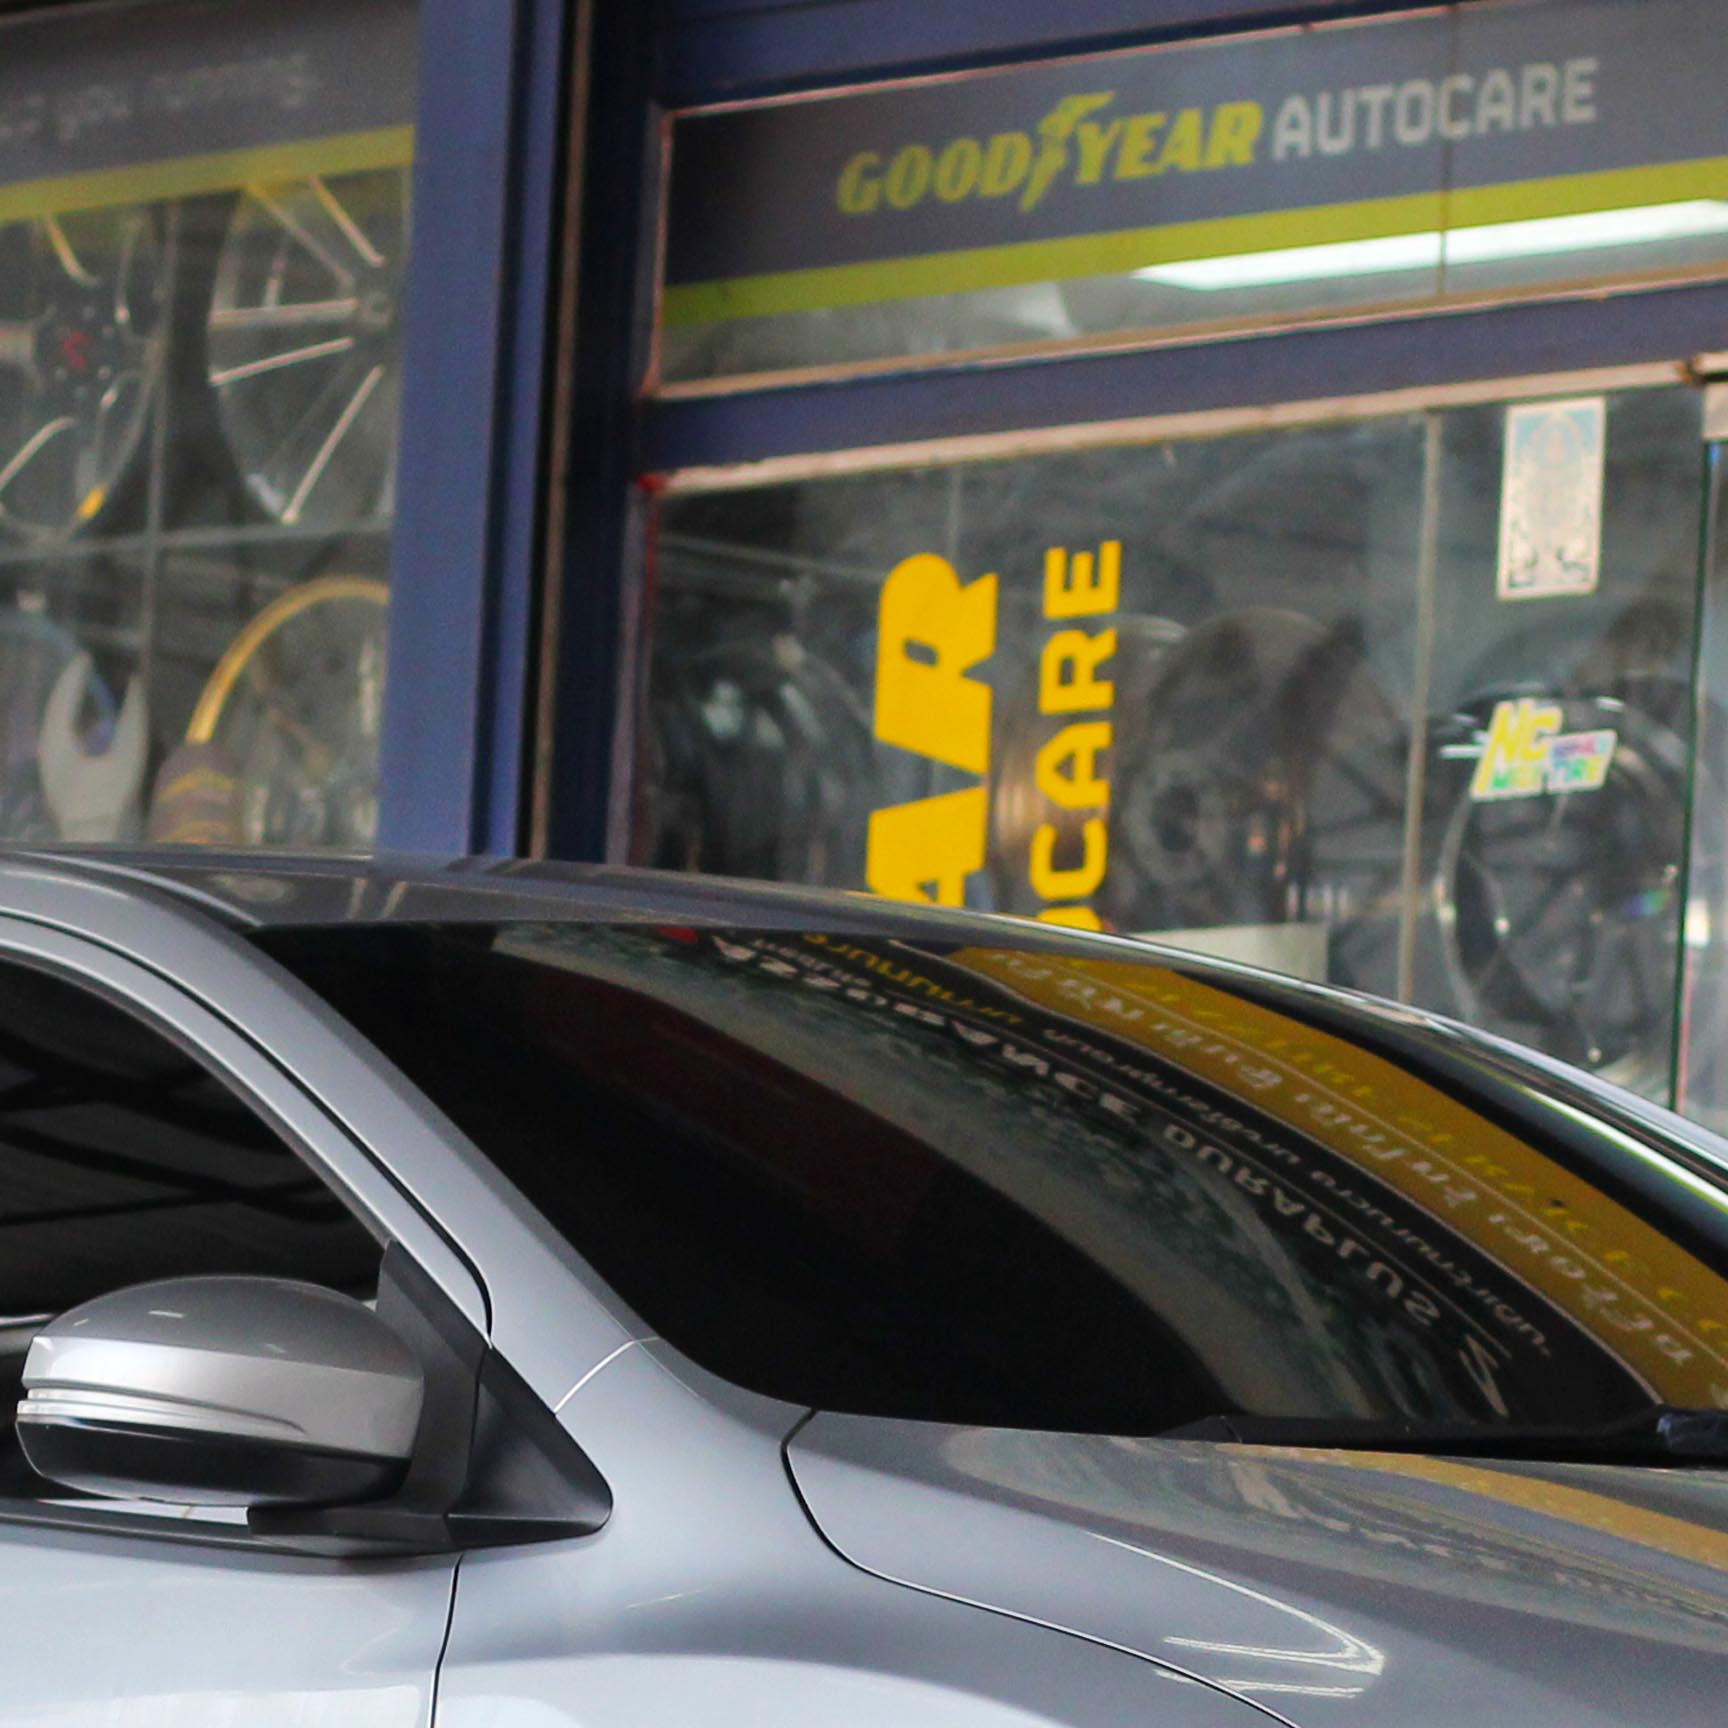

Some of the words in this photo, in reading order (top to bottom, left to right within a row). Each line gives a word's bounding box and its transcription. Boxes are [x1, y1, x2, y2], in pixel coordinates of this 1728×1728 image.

[837, 92, 1262, 214] GOODYEAR
[1271, 58, 1599, 160] AUTOCARE
[1475, 702, 1558, 793] NC
